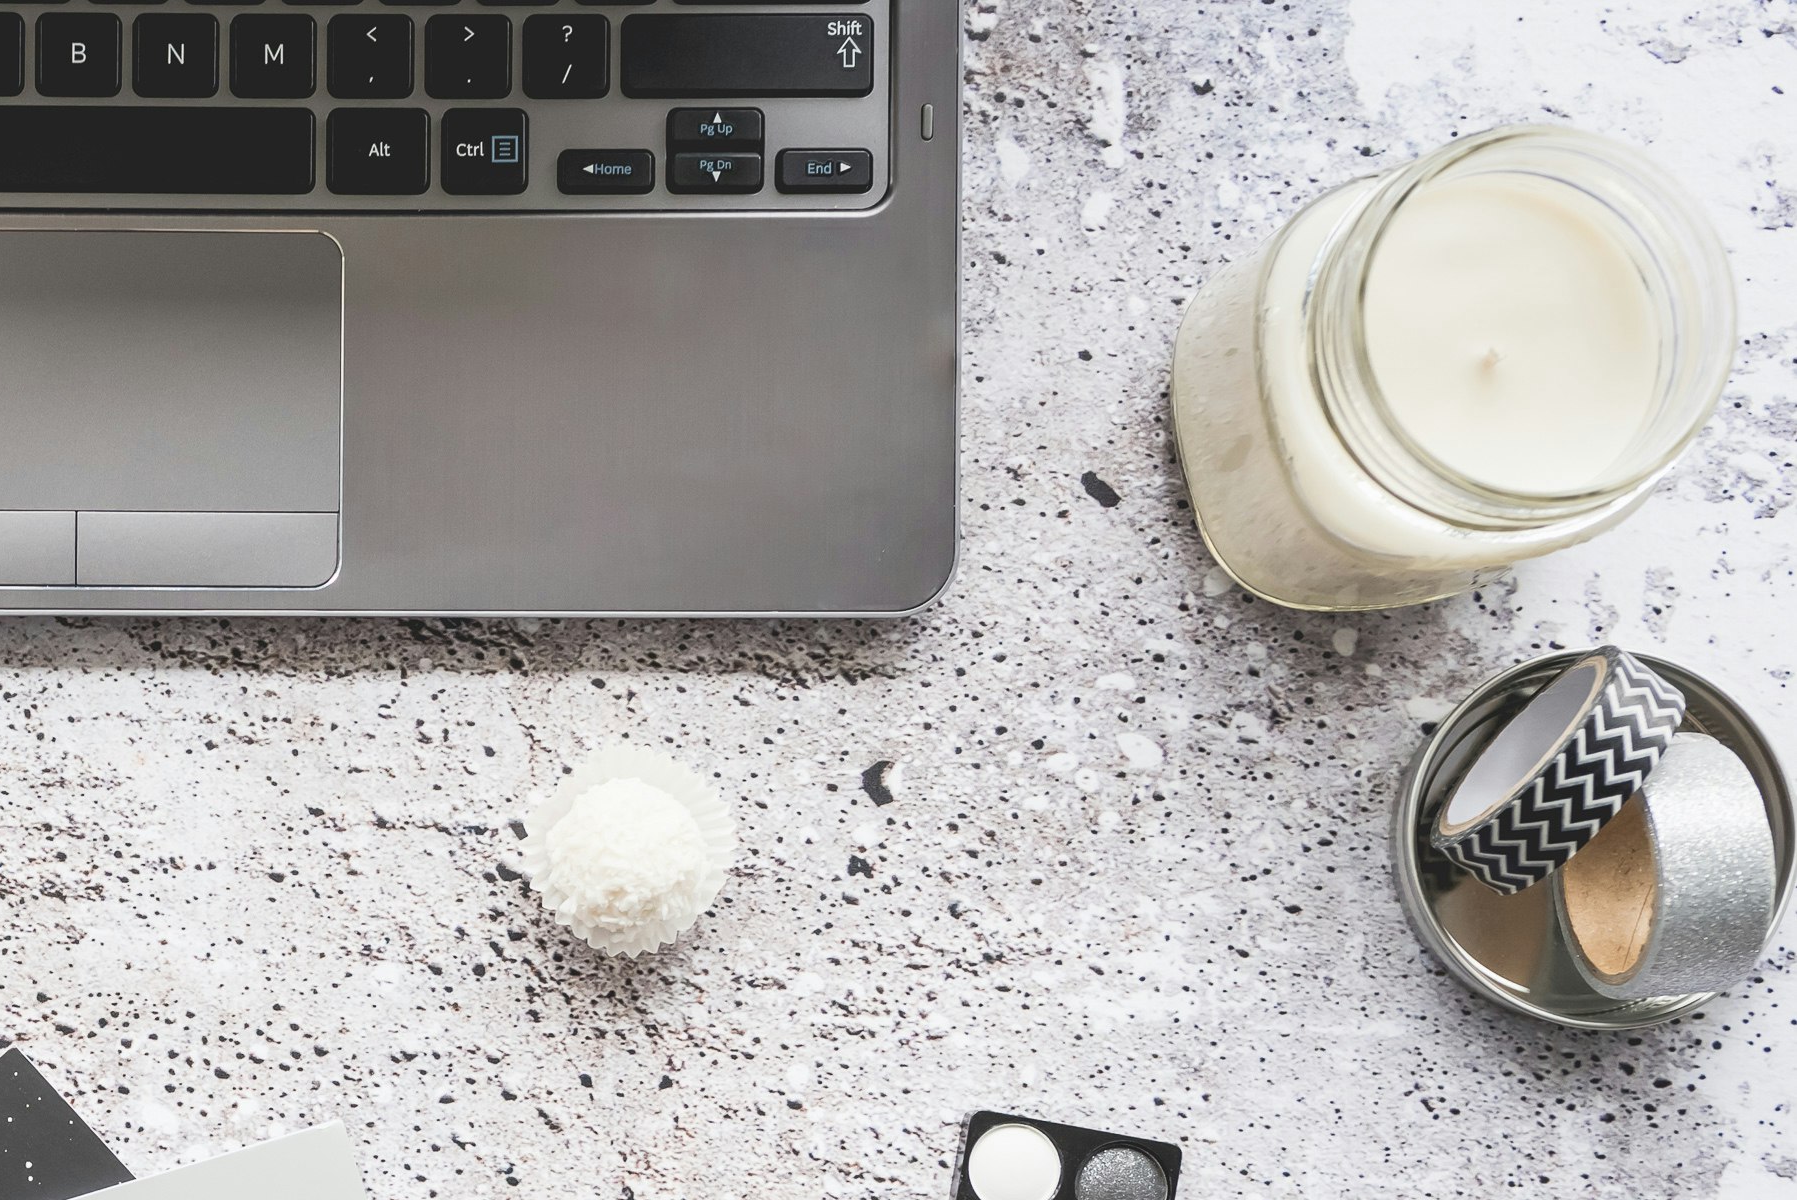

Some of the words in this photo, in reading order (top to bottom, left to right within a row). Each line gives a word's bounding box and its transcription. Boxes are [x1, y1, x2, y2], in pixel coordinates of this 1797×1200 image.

[827, 21, 863, 37] Shift
[71, 42, 87, 64] B
[167, 43, 185, 65] N
[264, 43, 284, 65] M
[700, 123, 715, 136] Pg
[717, 124, 733, 136] Up
[368, 141, 391, 157] Alt
[456, 141, 485, 157] Ctrl
[594, 163, 632, 175] Home
[699, 159, 714, 172] Pg
[717, 160, 732, 170] Dn
[807, 162, 832, 174] End
